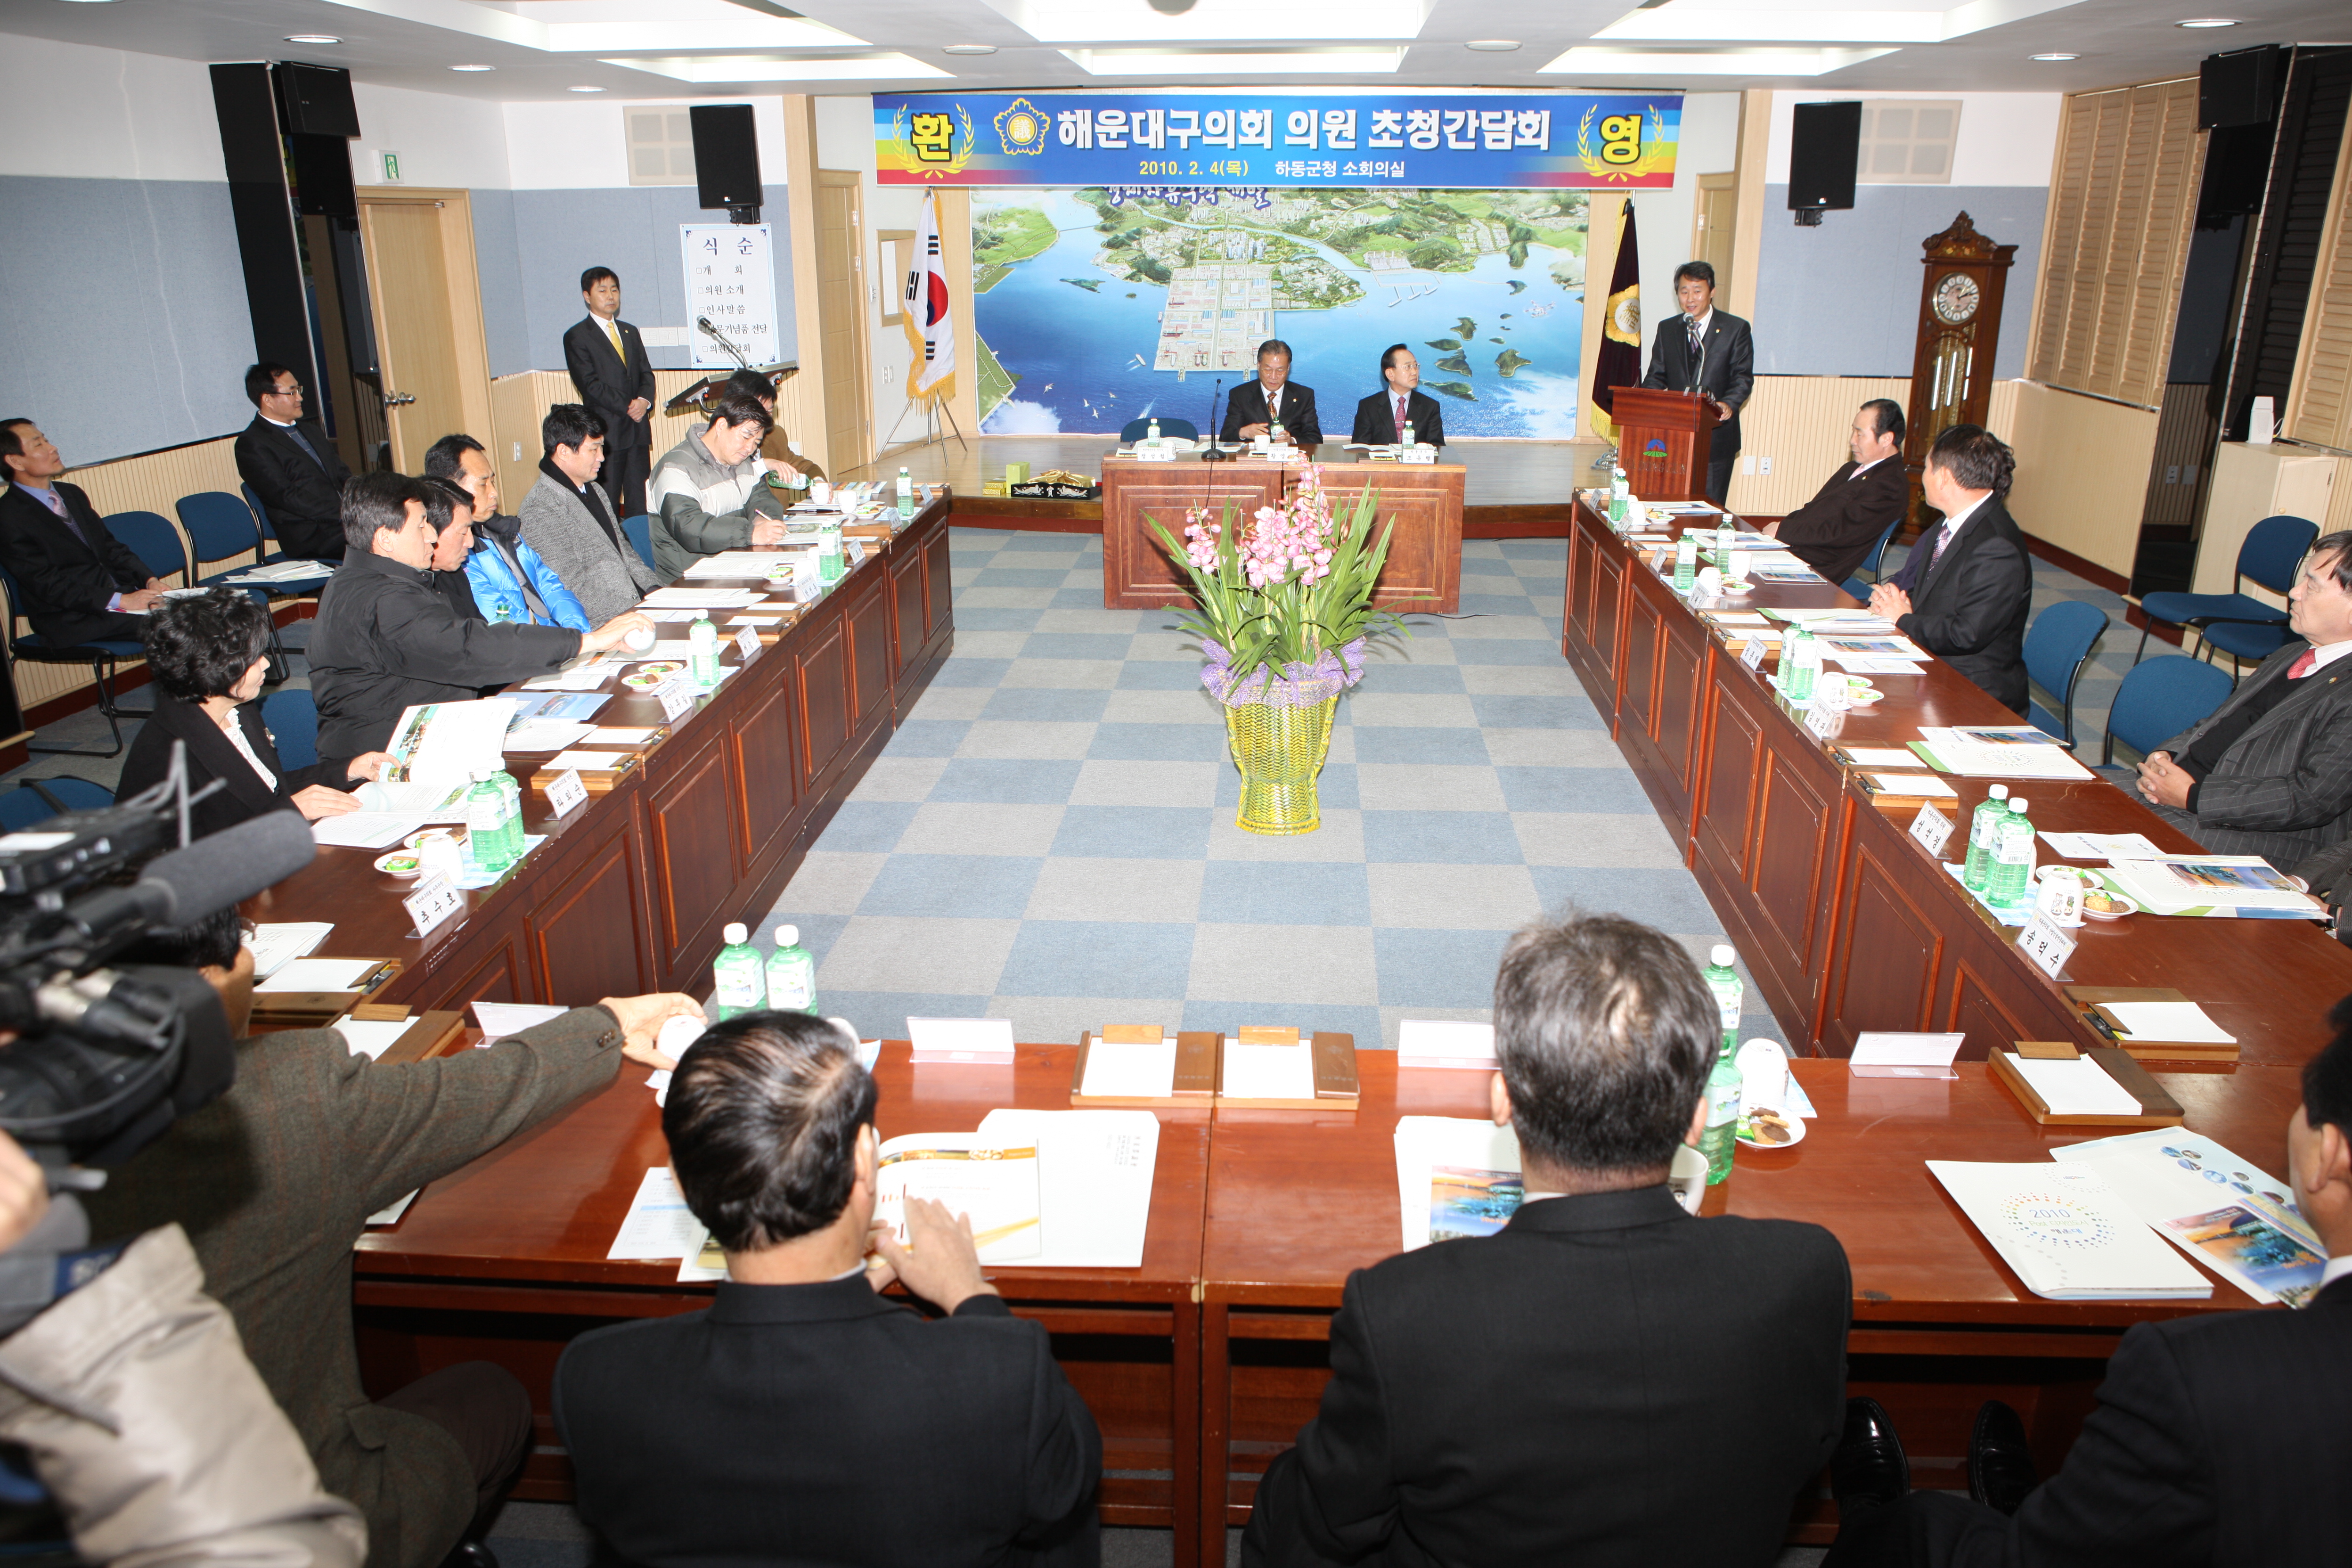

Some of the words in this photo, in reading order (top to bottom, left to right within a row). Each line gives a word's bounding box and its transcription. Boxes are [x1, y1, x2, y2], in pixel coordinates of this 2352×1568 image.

[911, 112, 954, 162] 환
[1013, 120, 1030, 139] 議
[1057, 108, 1272, 149] 해운대구의회
[1285, 109, 1356, 149] 의원
[1368, 109, 1550, 150] 초청간담회
[1599, 114, 1643, 164] 영
[1140, 161, 1182, 176] 2010.
[1189, 161, 1203, 176] 2.
[1209, 160, 1249, 177] 4(목)
[1275, 161, 1337, 177] 하동군청
[1342, 161, 1405, 178] 소회의실
[705, 285, 722, 295] 의원
[726, 285, 744, 295] 소개
[706, 304, 746, 315] 인사말씀
[751, 323, 768, 334] 전달
[2029, 1209, 2070, 1218] 2010
